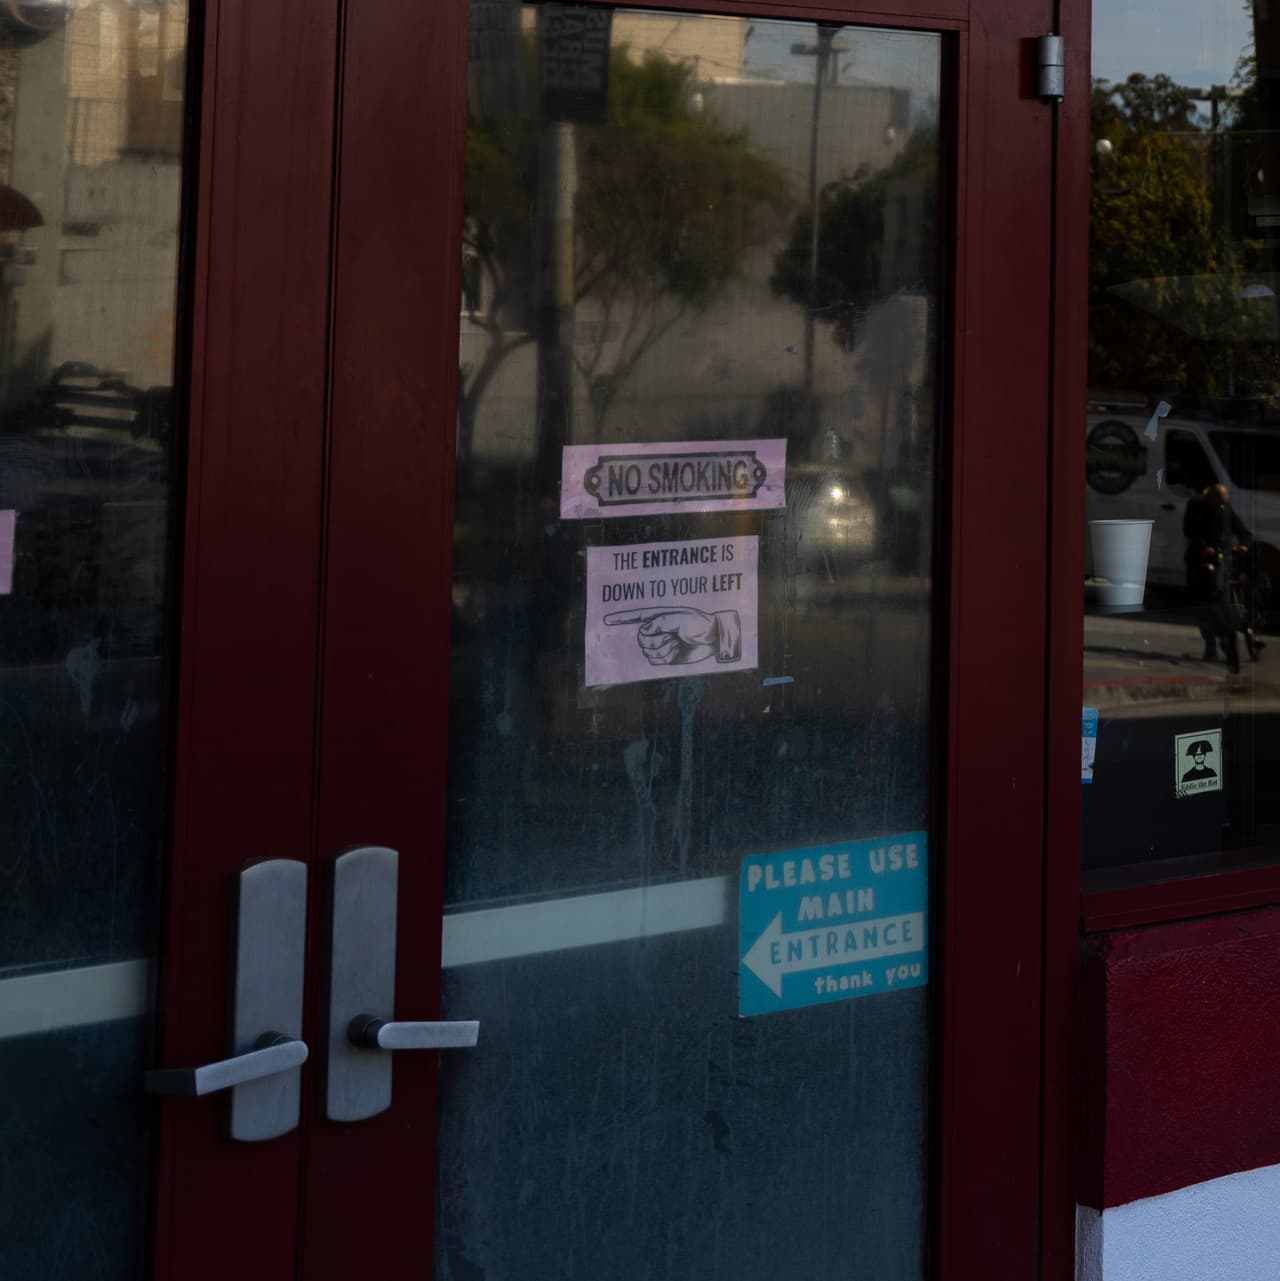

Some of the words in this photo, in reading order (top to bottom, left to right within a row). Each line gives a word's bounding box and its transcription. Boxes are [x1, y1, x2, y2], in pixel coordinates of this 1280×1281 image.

[607, 464, 642, 497] NO
[647, 459, 749, 494] SMOKING
[612, 551, 638, 571] THE
[642, 544, 717, 569] ENTRANCE
[721, 543, 734, 562] IS
[602, 581, 645, 603] DOWN
[649, 579, 666, 599] TO
[671, 575, 708, 596] YOUR
[712, 572, 743, 593] LEFT
[746, 853, 852, 894] PLEASE
[868, 843, 920, 874] USE
[797, 887, 875, 921] MAIN
[770, 920, 913, 965] ENTRANCE
[814, 969, 874, 995] thank
[884, 961, 922, 986] you
